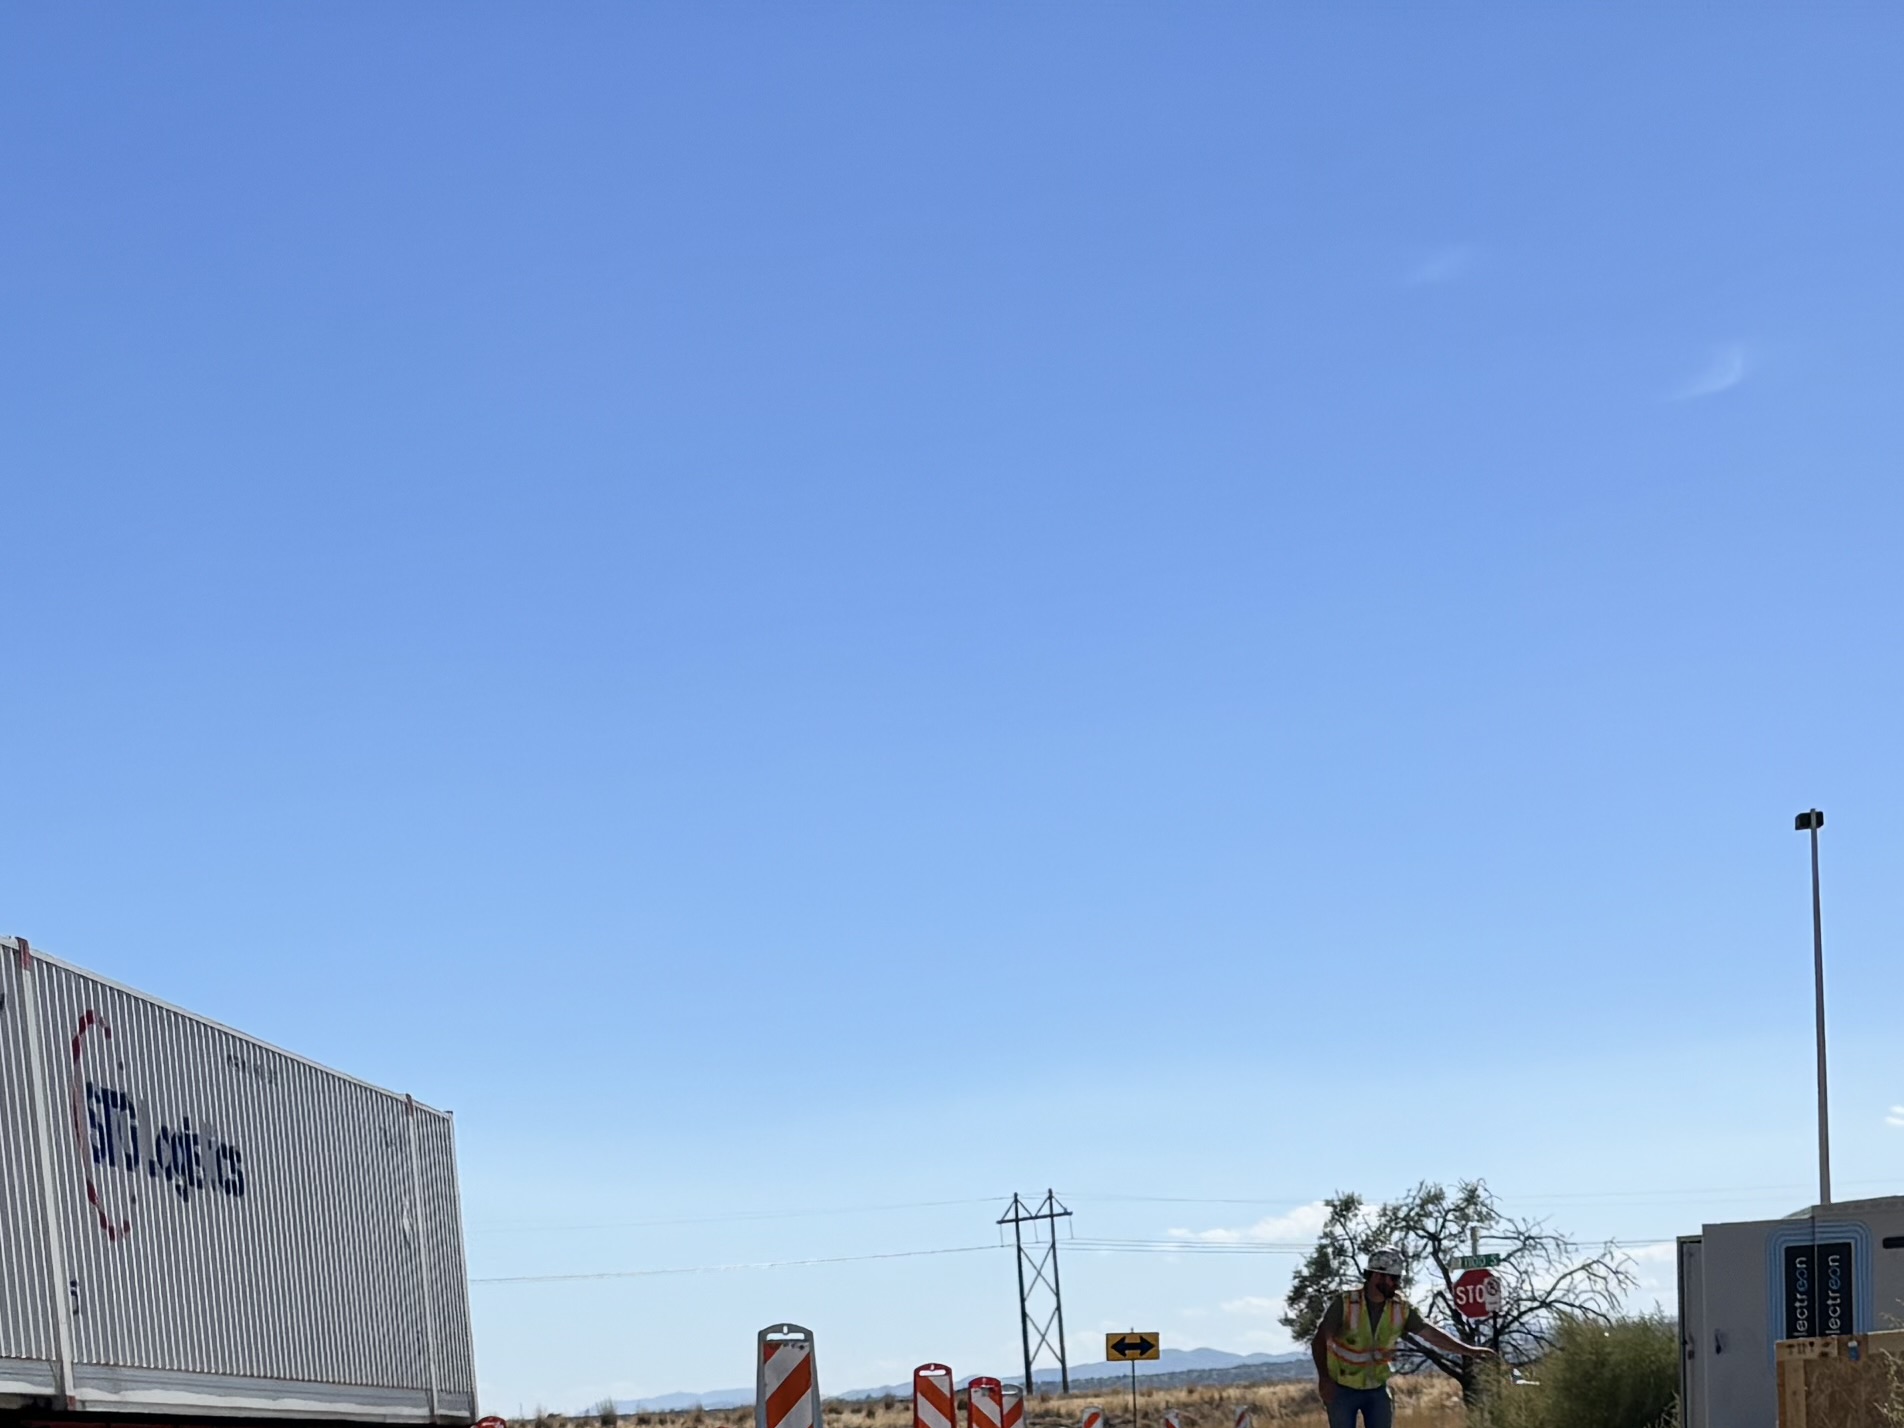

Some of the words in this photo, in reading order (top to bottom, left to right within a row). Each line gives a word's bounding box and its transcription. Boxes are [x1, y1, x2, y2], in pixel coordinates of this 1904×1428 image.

[1456, 1283, 1485, 1306] STO
[1793, 1256, 1808, 1336] lectreon
[1825, 1254, 1841, 1335] lectreon
